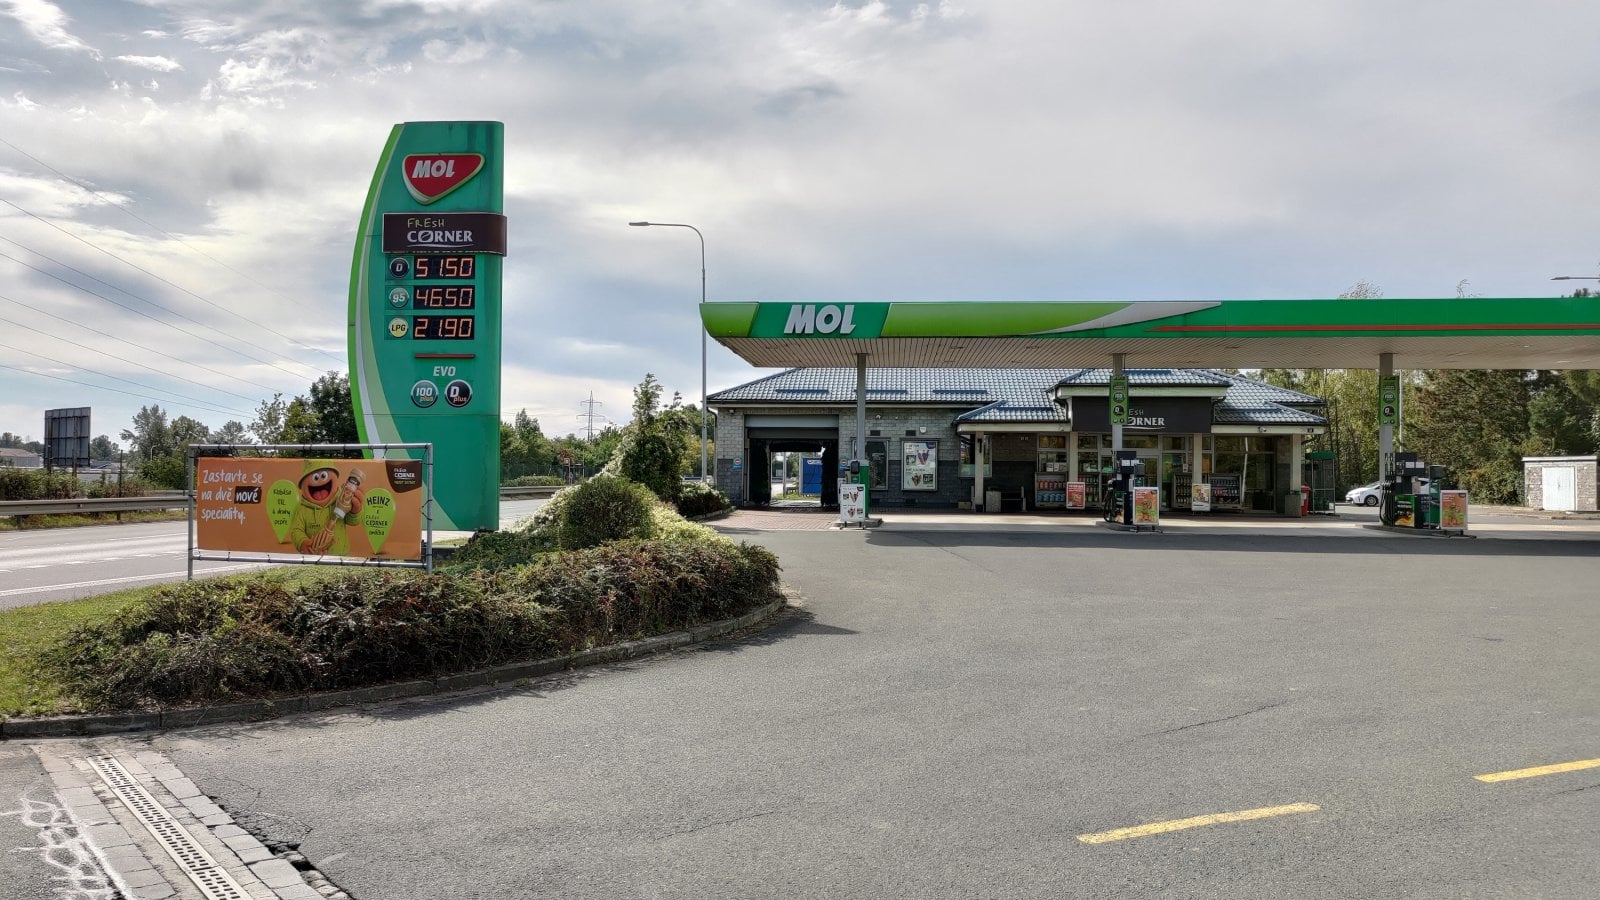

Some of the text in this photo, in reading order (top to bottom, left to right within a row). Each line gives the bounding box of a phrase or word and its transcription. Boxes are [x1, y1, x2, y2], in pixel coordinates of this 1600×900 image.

[412, 160, 455, 178] MOL
[407, 217, 445, 228] FRESH
[395, 263, 403, 272] D
[392, 293, 405, 303] 95
[783, 304, 856, 335] MOL
[391, 324, 406, 333] LPG
[433, 366, 456, 377] EVO
[415, 387, 433, 397] 100
[449, 386, 459, 398] D
[1127, 416, 1165, 426] ORNER
[203, 469, 263, 484] Zastavte se
[201, 488, 258, 503] na dvě nové
[366, 496, 391, 507] HEINZ
[202, 507, 246, 525] speciality.
